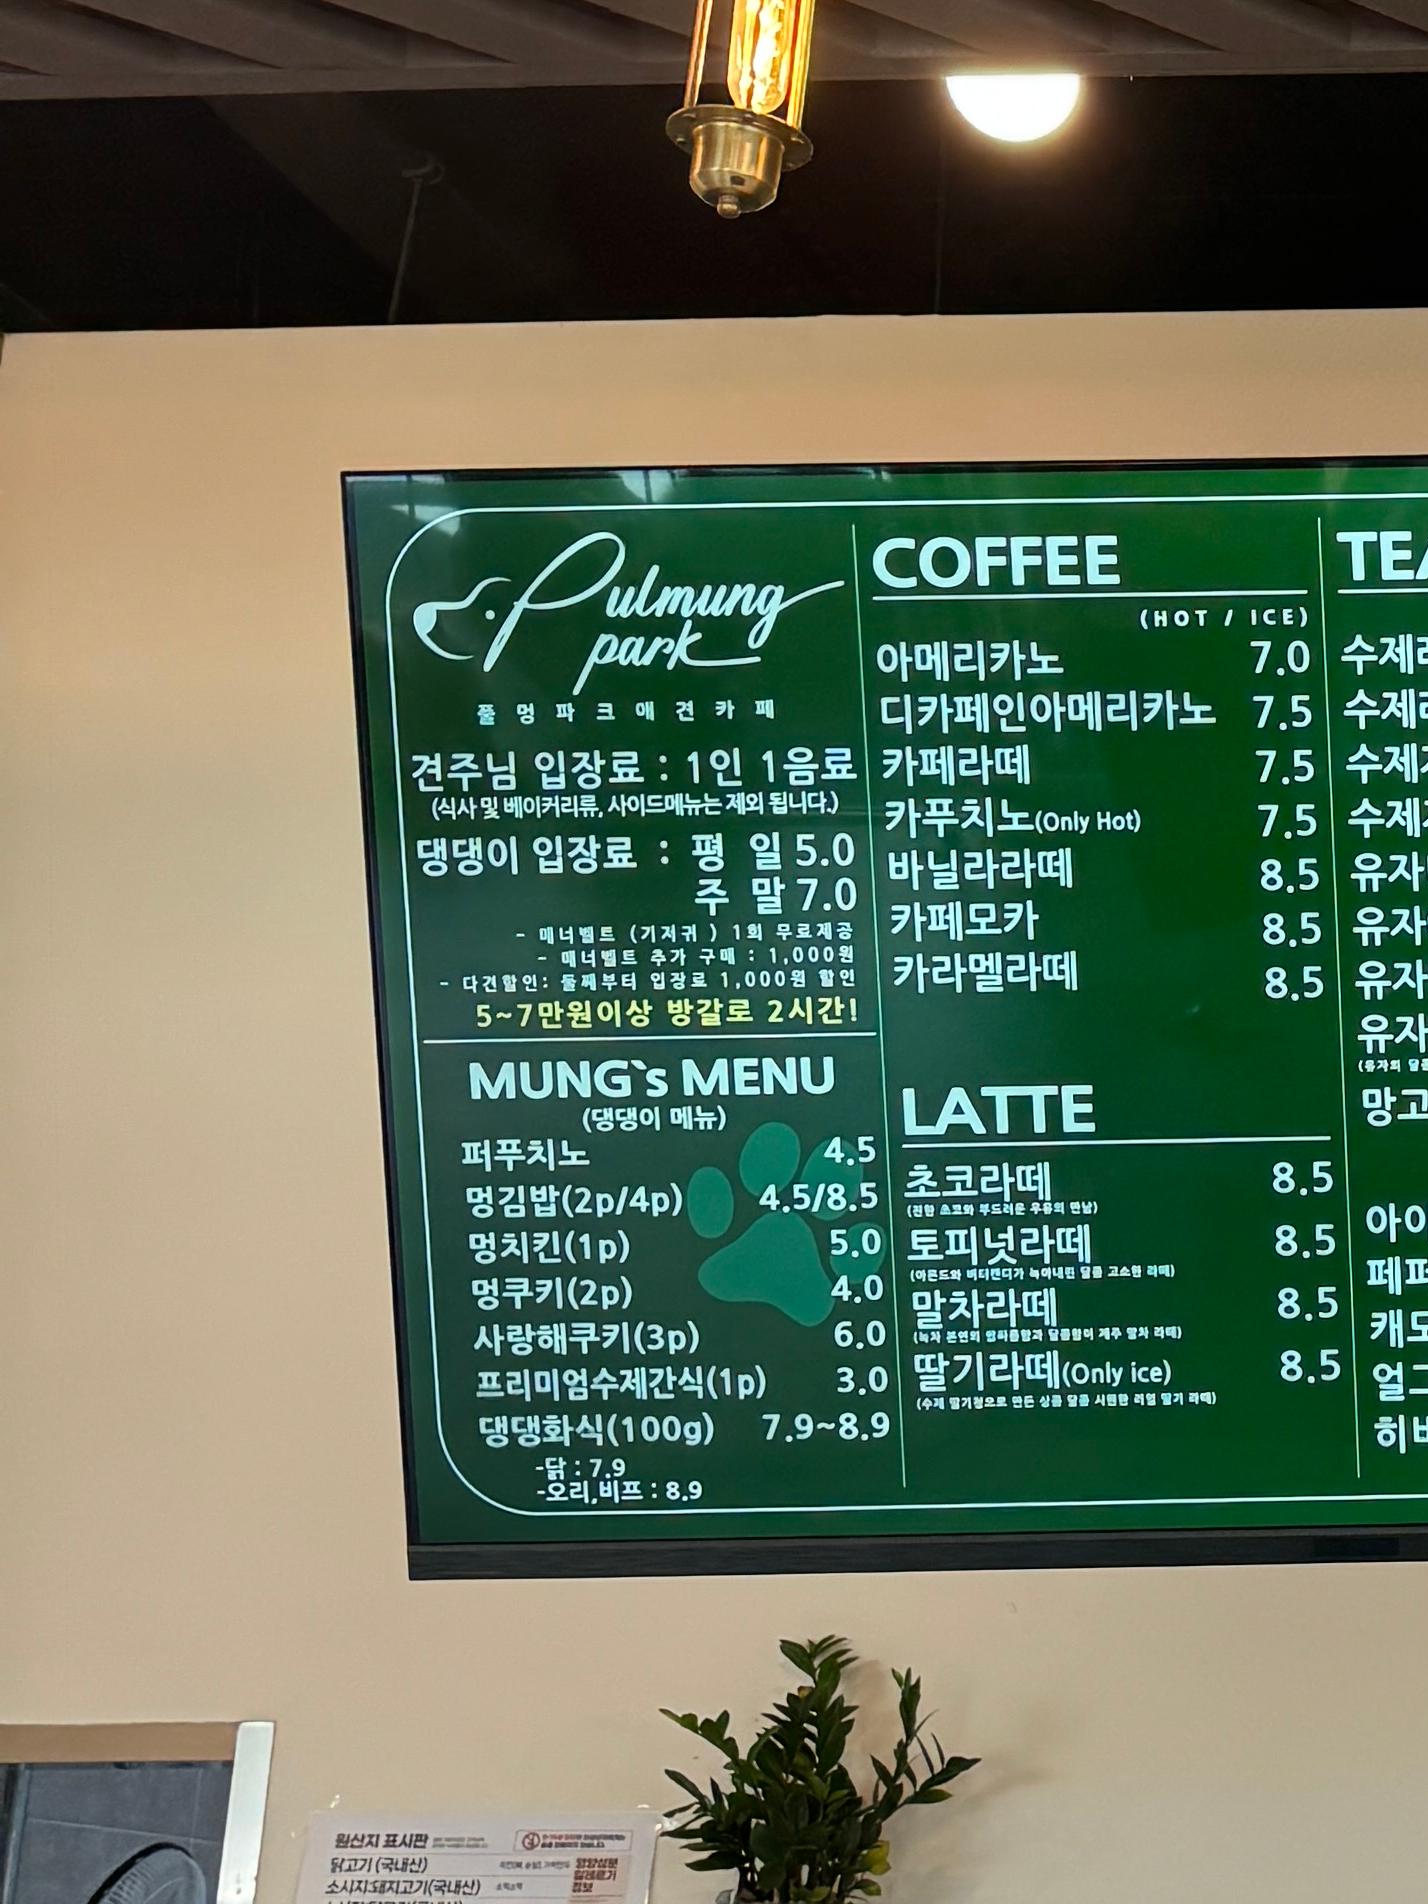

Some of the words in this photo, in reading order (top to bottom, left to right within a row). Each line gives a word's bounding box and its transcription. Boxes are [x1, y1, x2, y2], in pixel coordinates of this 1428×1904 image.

[872, 535, 1121, 589] COFFEE
[572, 619, 761, 696] park
[876, 639, 1064, 683] 아메리카노
[1250, 640, 1310, 676] 7.0
[880, 689, 1217, 735] 디카페인아메리카노
[1252, 694, 1312, 731] 7.5
[411, 750, 517, 793] 견주님
[534, 749, 645, 791] 입장료
[687, 747, 743, 787] 1인
[761, 746, 858, 787] 1음료
[431, 796, 478, 821] (식사
[480, 796, 500, 820] 및
[503, 794, 604, 819] 베이커리류,
[607, 792, 723, 818] 사이드메뉴는
[725, 791, 764, 816] 제외
[767, 790, 839, 815] 됩니다.)
[893, 950, 1078, 994] 카라멜라떼
[1264, 965, 1324, 1002] 8.5
[476, 999, 653, 1029] 5~7만원이상
[667, 997, 754, 1027] 방갈로
[767, 995, 857, 1025] 2시간!
[681, 1056, 835, 1097] MENU
[582, 1106, 661, 1134] (댕댕이
[669, 1104, 727, 1131] 메뉴)
[902, 1084, 1096, 1136] LATTE
[461, 1138, 591, 1173] 퍼푸치노
[823, 1135, 876, 1167] 4.5
[465, 1182, 683, 1219] 멍김밥(2p/4p)
[758, 1182, 879, 1214] 4.5/8.5
[903, 1161, 1052, 1203] 초코라떼
[1272, 1160, 1334, 1196] 8.5
[478, 1411, 714, 1448] 댕댕화식(100g)
[762, 1411, 890, 1443] 7.9~8.9
[335, 1833, 380, 1849] 원산지
[382, 1833, 428, 1848] 표시판
